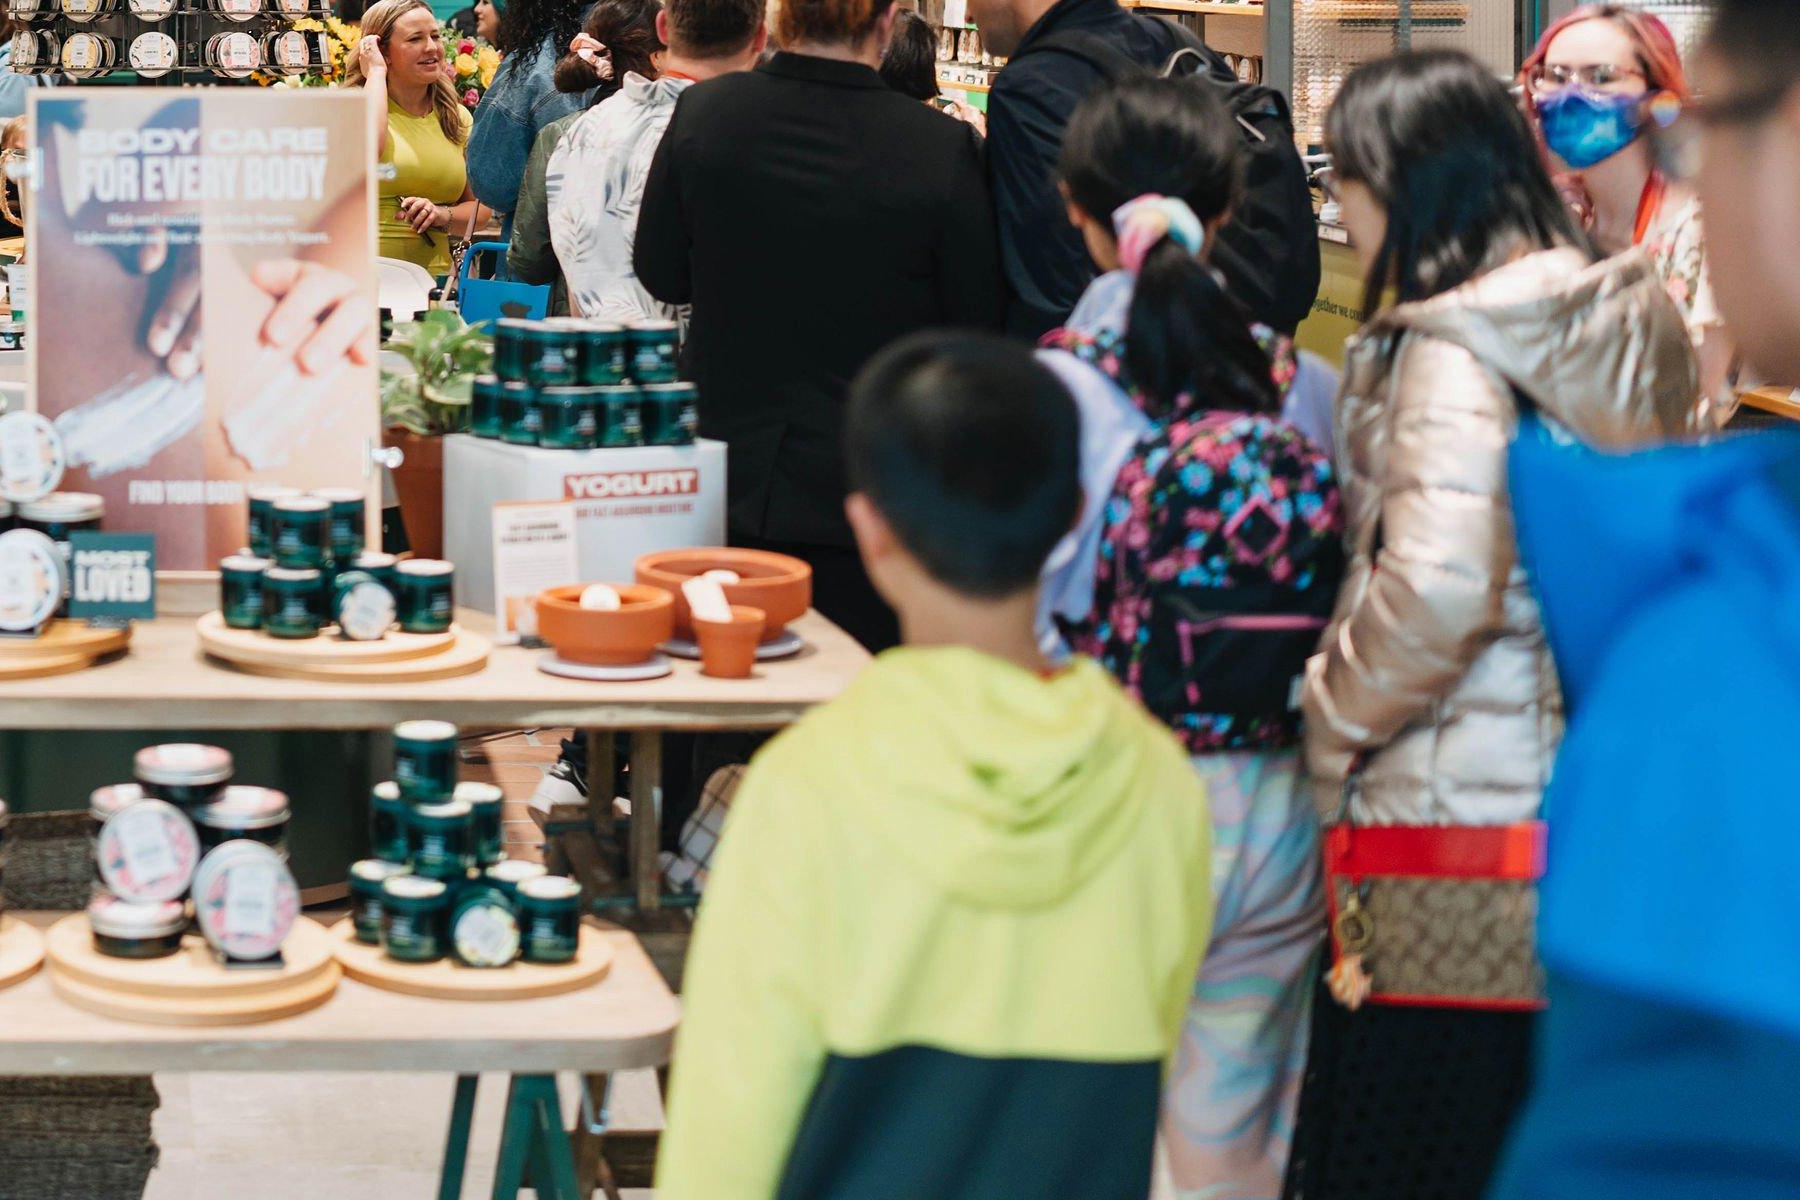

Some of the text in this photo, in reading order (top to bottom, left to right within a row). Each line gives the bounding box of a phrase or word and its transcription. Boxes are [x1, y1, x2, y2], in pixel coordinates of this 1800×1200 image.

[80, 127, 328, 154] BODY CARE
[78, 154, 328, 202] FOR EVERY BODY
[567, 471, 697, 497] YOGURT
[75, 549, 151, 567] MOST
[75, 564, 152, 602] LOVED
